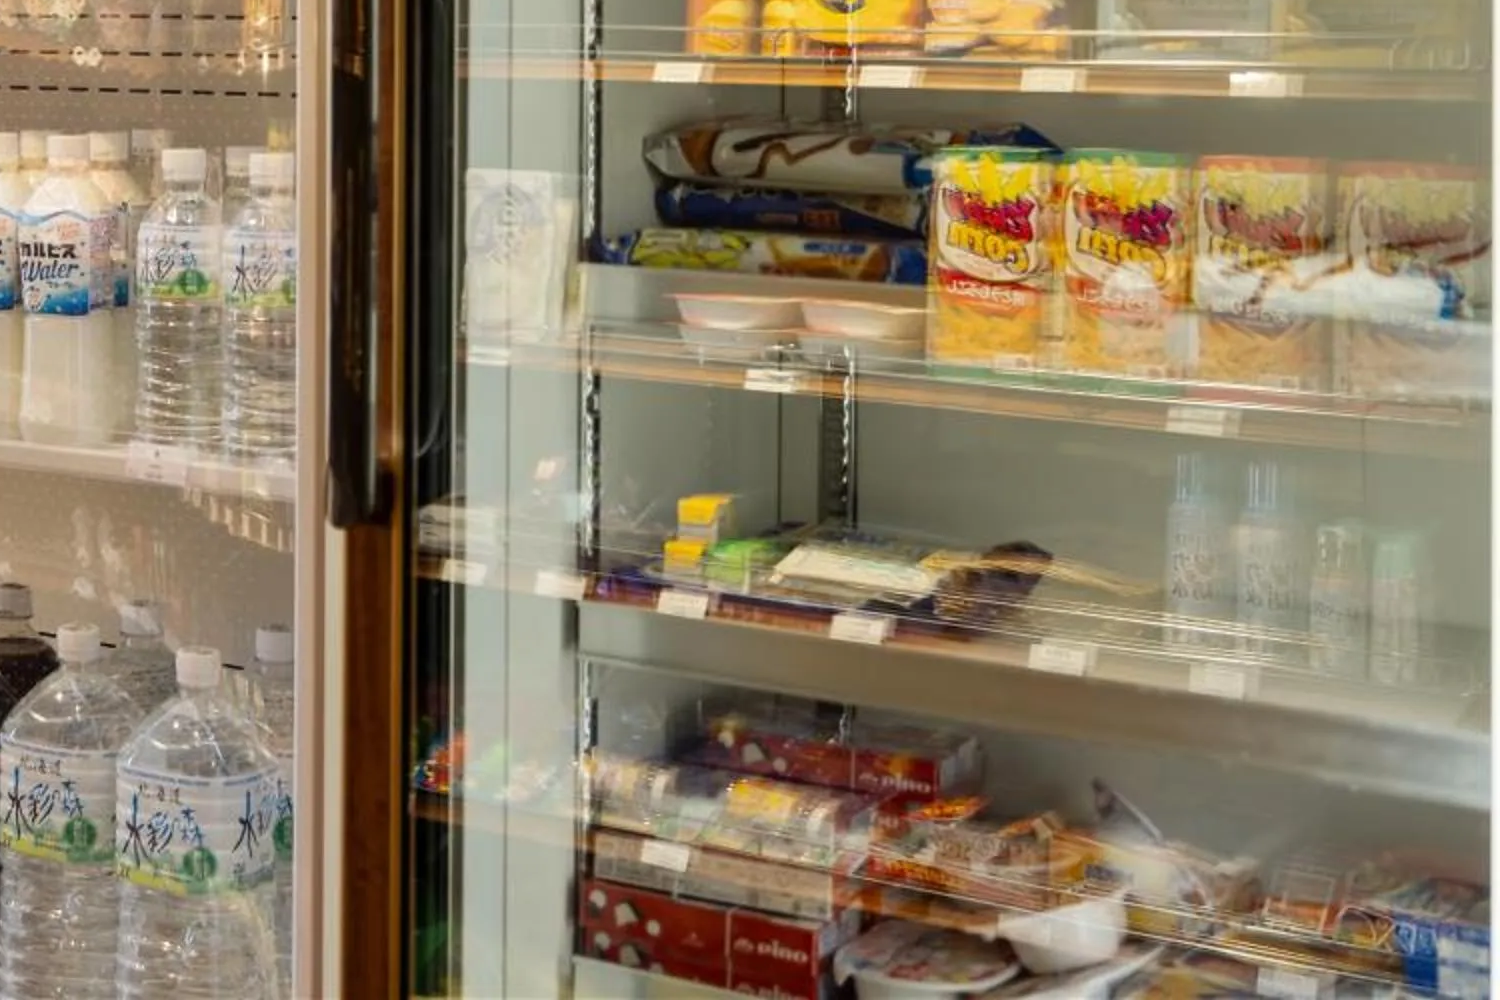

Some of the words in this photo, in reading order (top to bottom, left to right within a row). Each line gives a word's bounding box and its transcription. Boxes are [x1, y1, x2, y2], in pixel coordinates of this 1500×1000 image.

[20, 243, 76, 259] カルピス
[21, 260, 80, 282] Water
[880, 773, 932, 794] pino
[4, 766, 84, 841] 水彩の森
[122, 785, 204, 869] 水彩の森
[756, 941, 809, 965] pino
